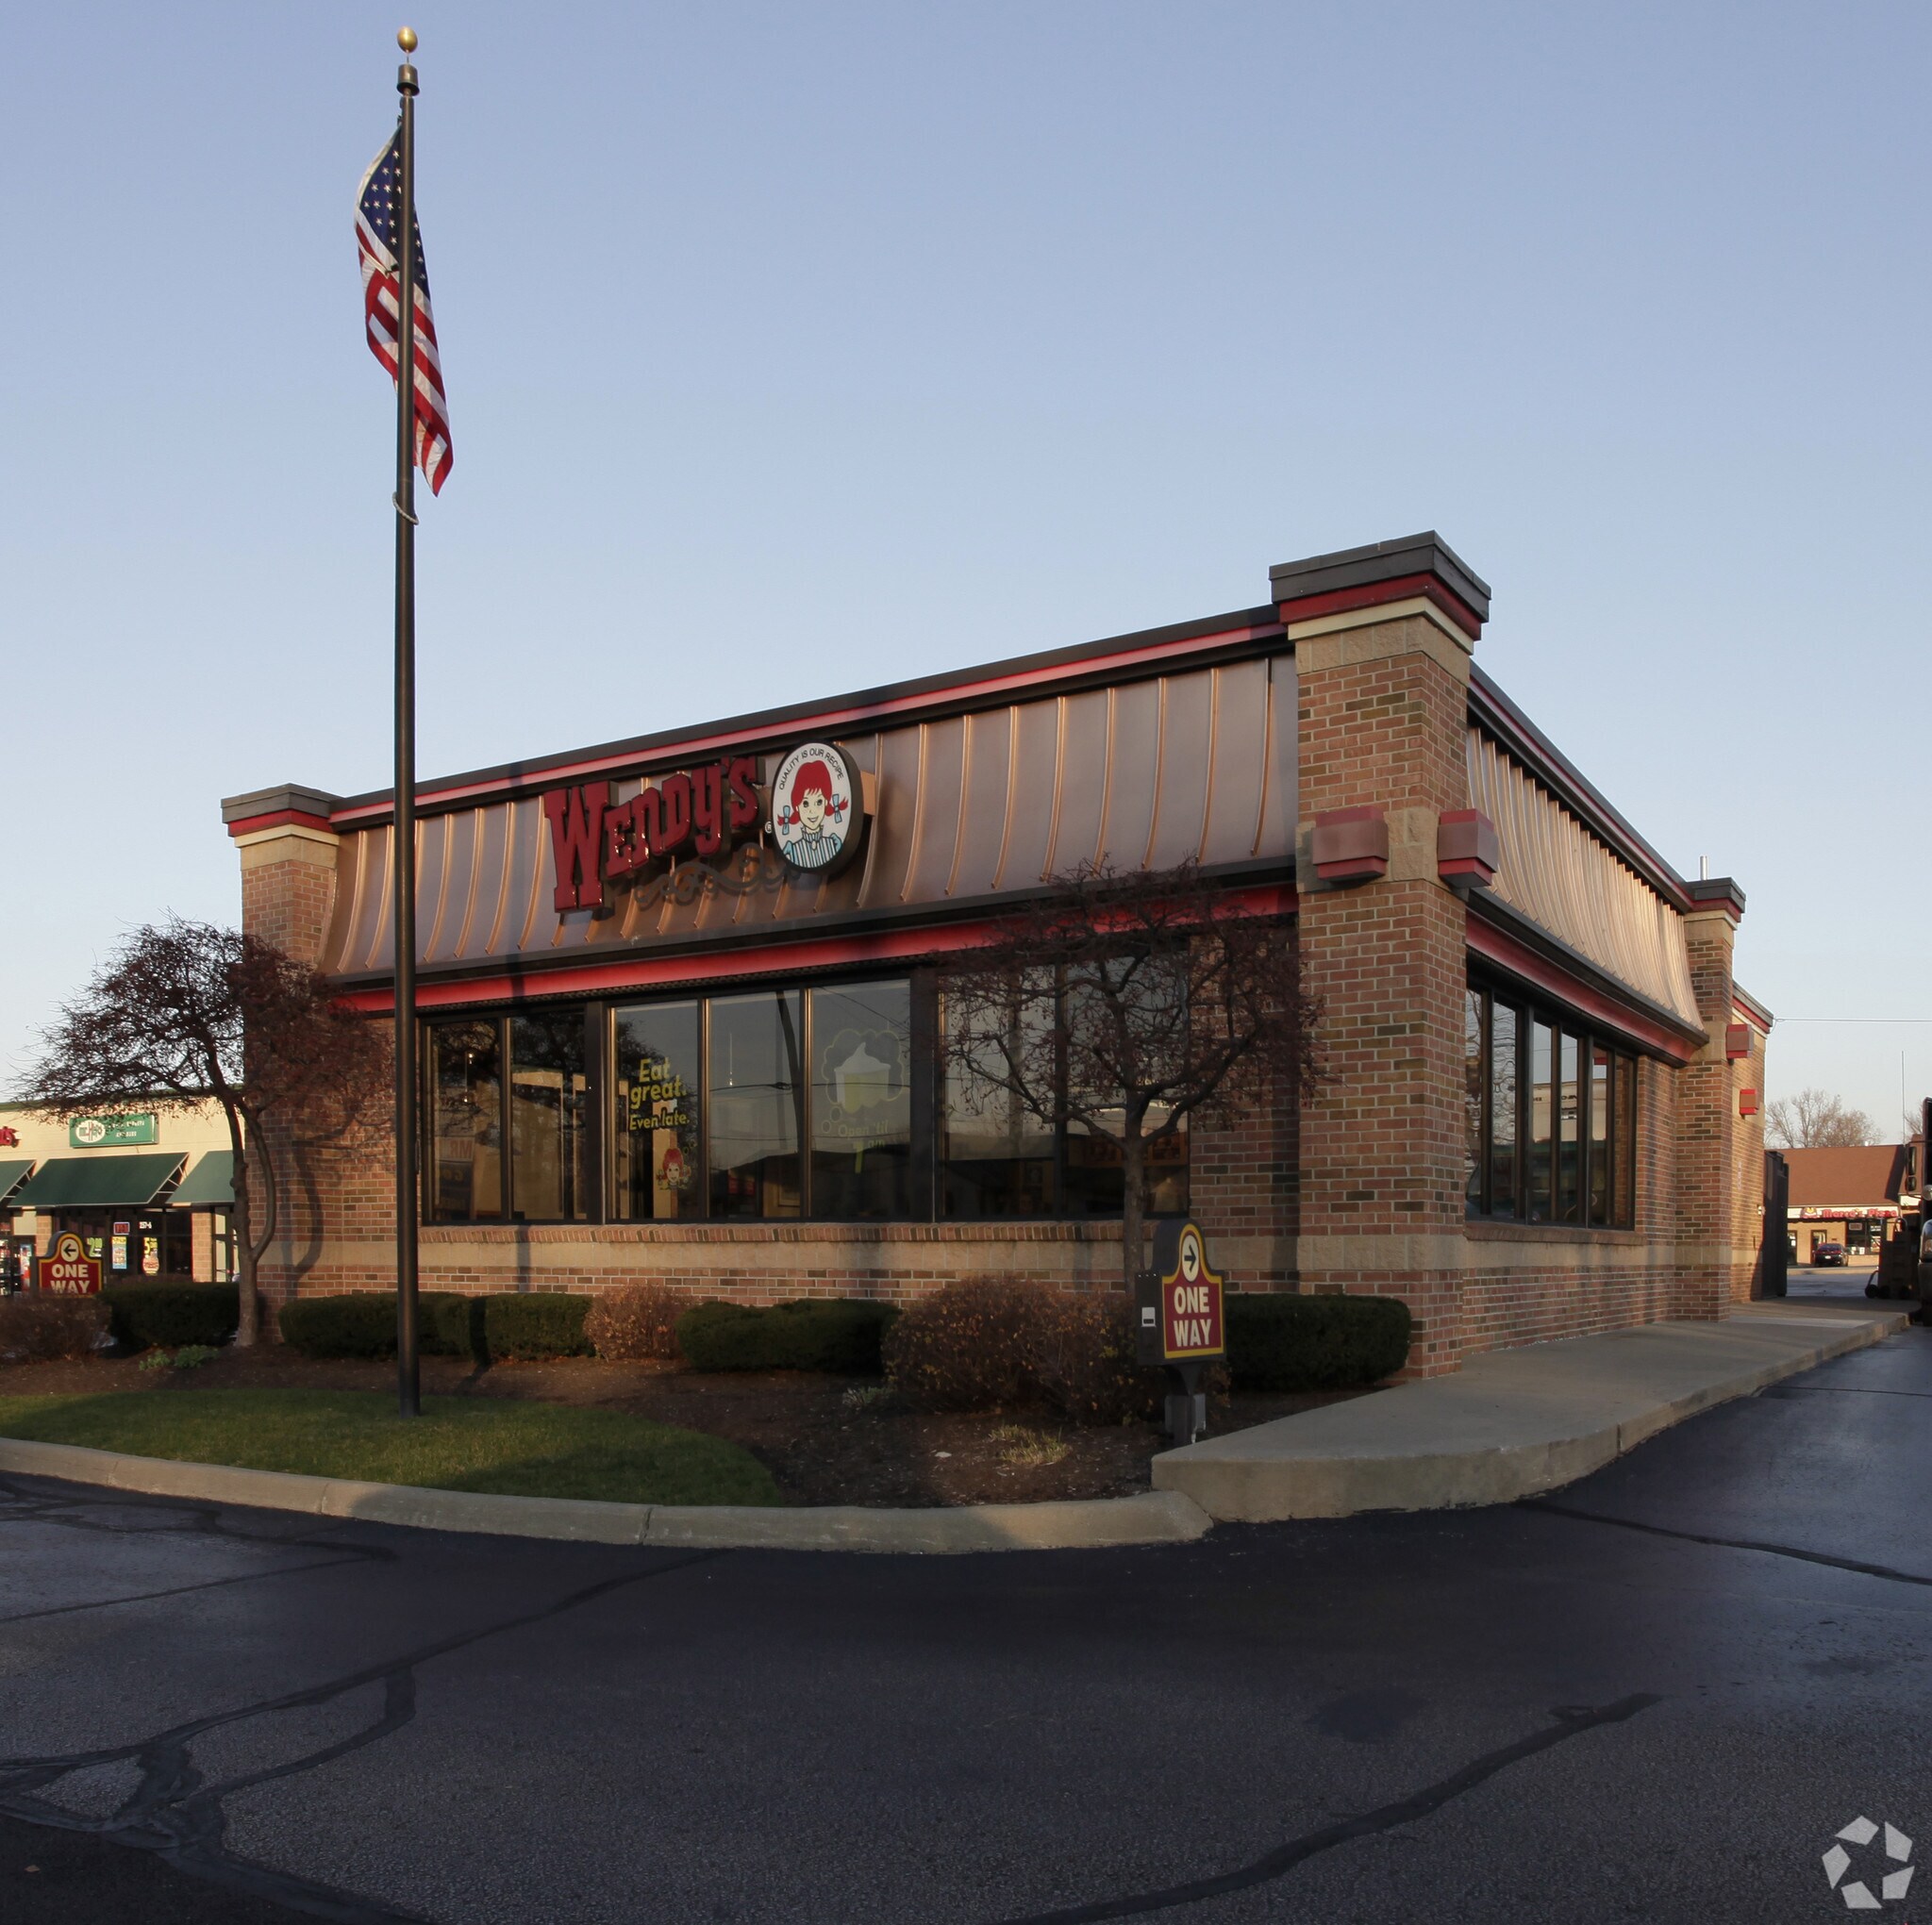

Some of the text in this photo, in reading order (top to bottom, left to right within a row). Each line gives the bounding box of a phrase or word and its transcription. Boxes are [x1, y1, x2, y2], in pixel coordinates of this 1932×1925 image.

[778, 747, 844, 790] QUALITY IS OUR RECIPE
[639, 1056, 671, 1083] Eat
[629, 1074, 687, 1110] great.
[629, 1108, 691, 1131] Even late.
[839, 1124, 869, 1140] Open
[52, 1264, 89, 1278] ONE
[50, 1280, 91, 1294] WAY
[1174, 1286, 1210, 1315] ONE
[1174, 1319, 1212, 1348] WAY
